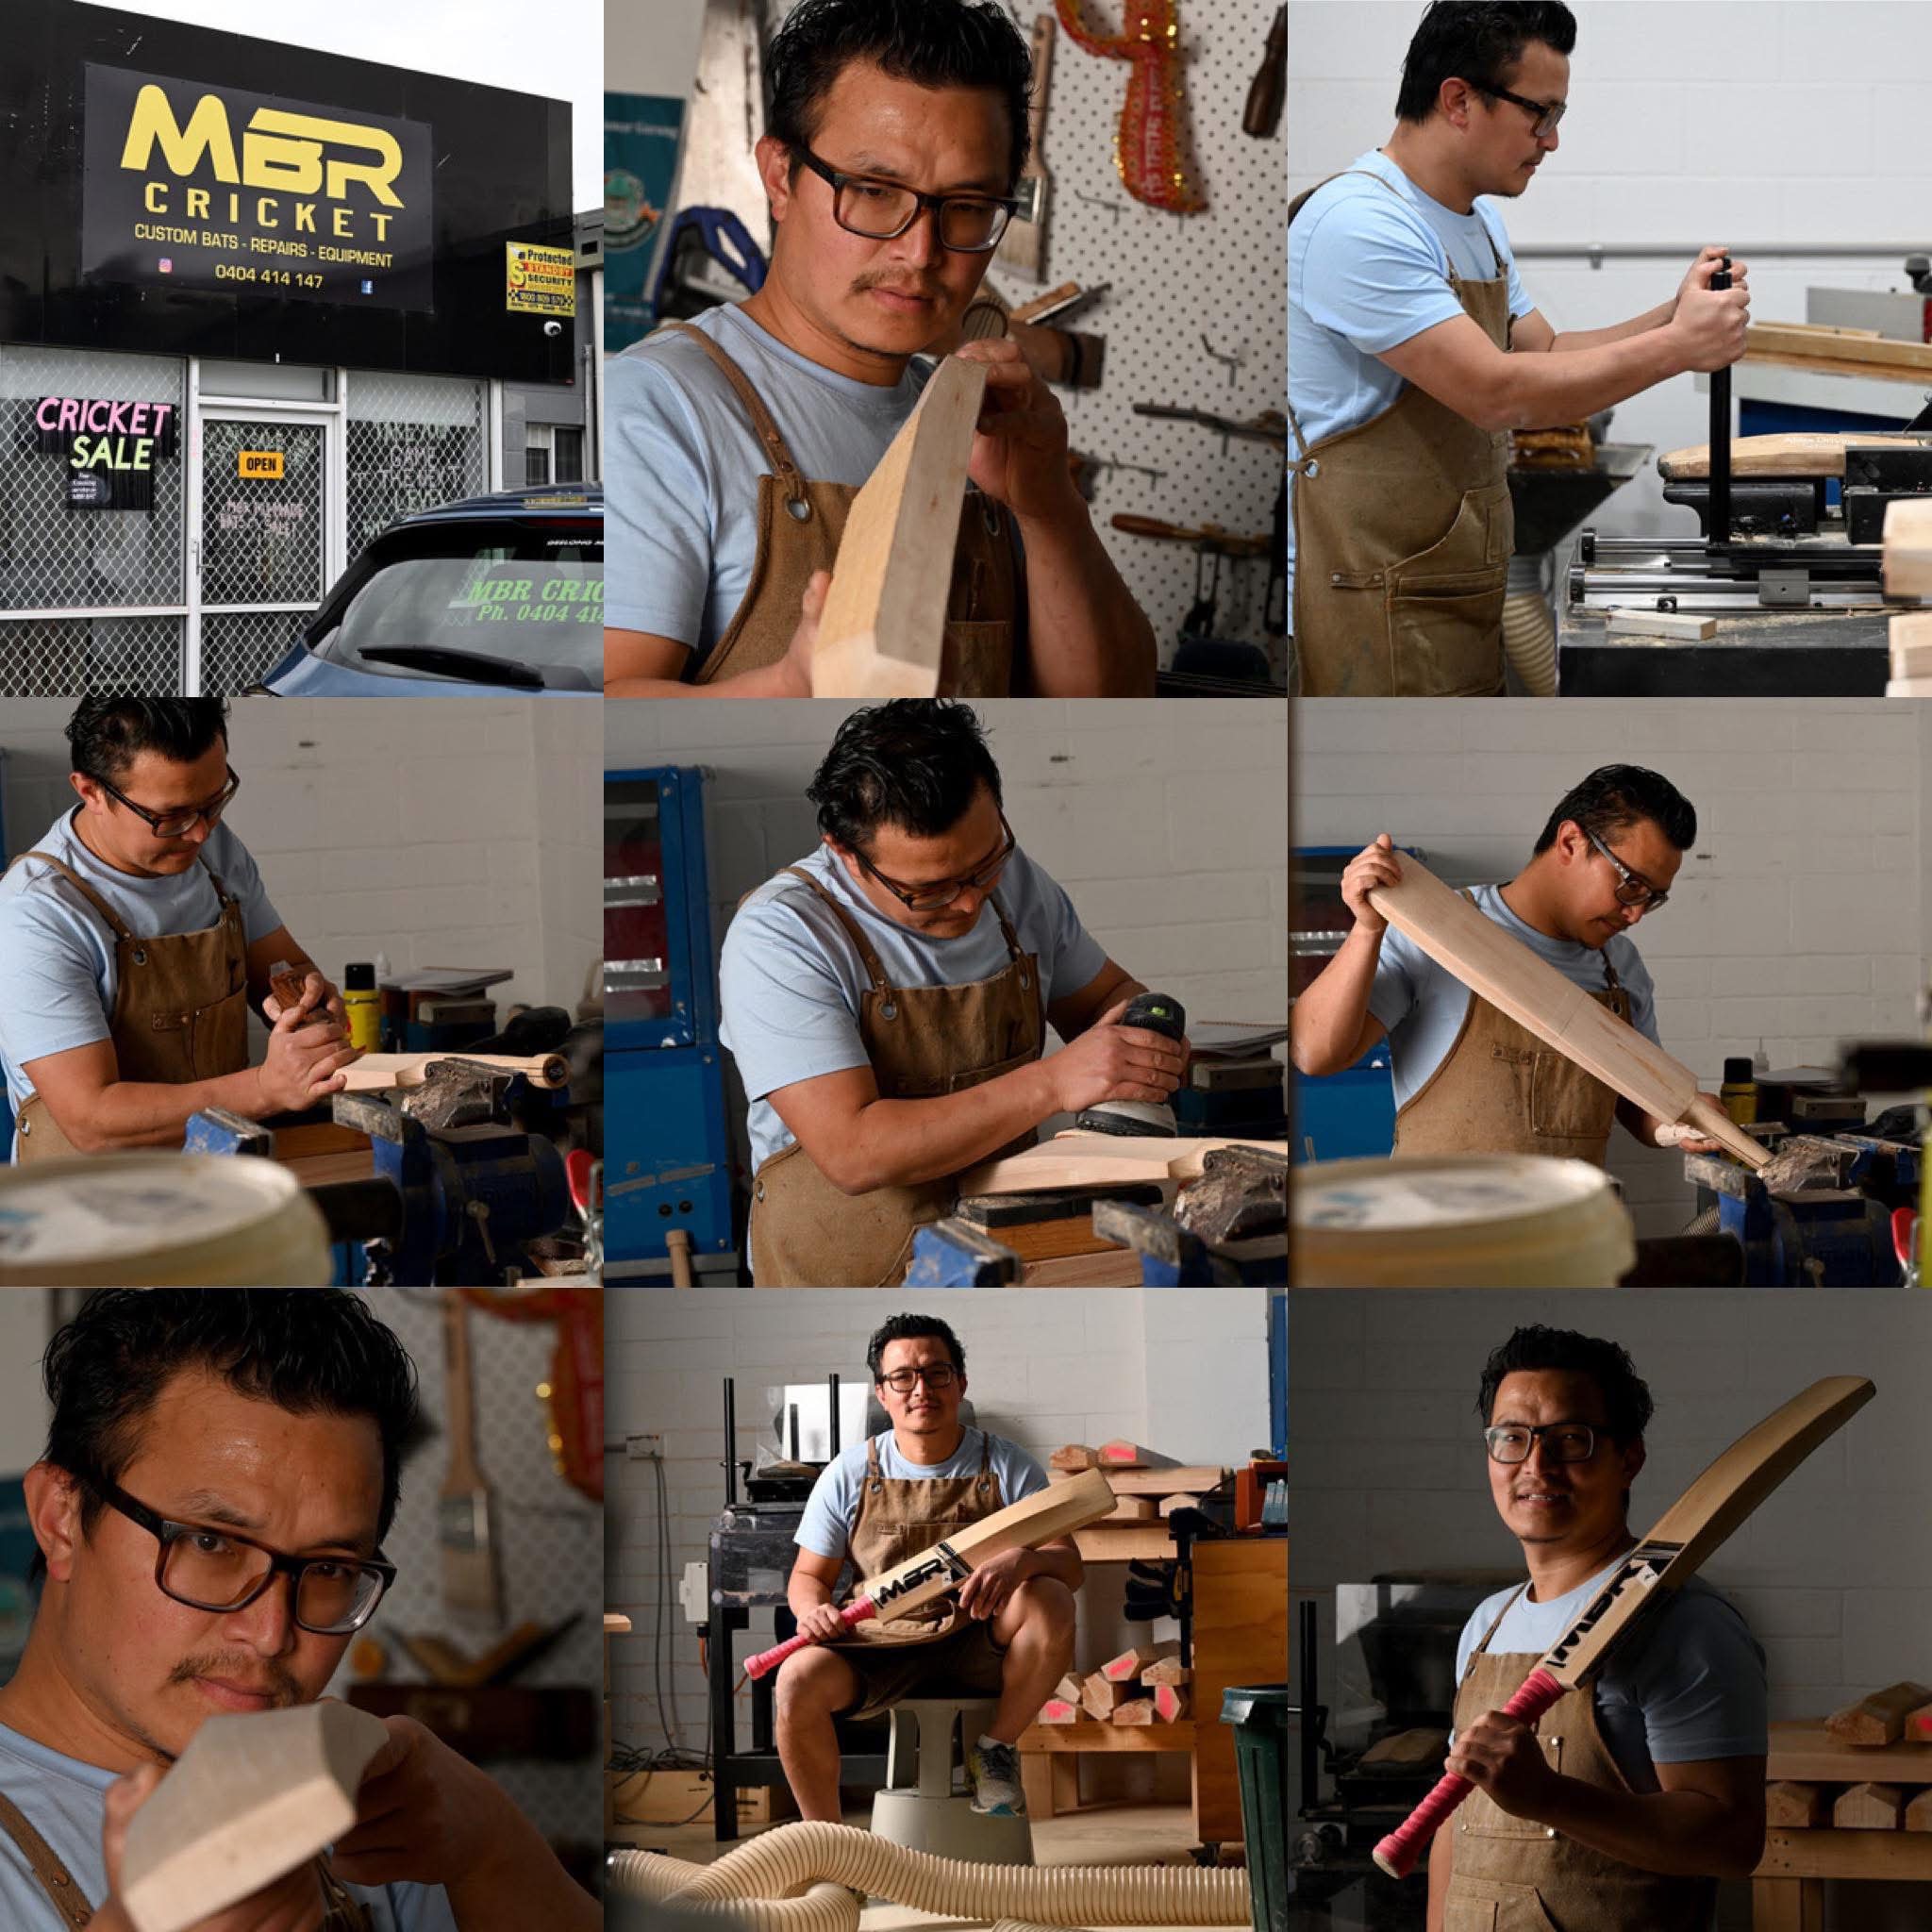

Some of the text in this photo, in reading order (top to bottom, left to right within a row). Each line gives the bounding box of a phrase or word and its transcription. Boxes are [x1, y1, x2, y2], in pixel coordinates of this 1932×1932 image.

[121, 84, 405, 208] MBR
[144, 182, 393, 242] CRICKET
[135, 224, 196, 244] CUSTOM
[202, 232, 238, 249] BATS
[251, 238, 308, 258] REPAIRS
[318, 246, 392, 268] EQUIPMENT
[528, 249, 573, 265] Protected
[215, 264, 323, 289] 0404 414 147
[36, 397, 172, 437] CRICKET
[70, 435, 154, 471] SALE
[246, 458, 276, 472] OPEN
[468, 578, 533, 604] MBR
[475, 604, 509, 622] Ph.
[516, 604, 570, 623] 0404
